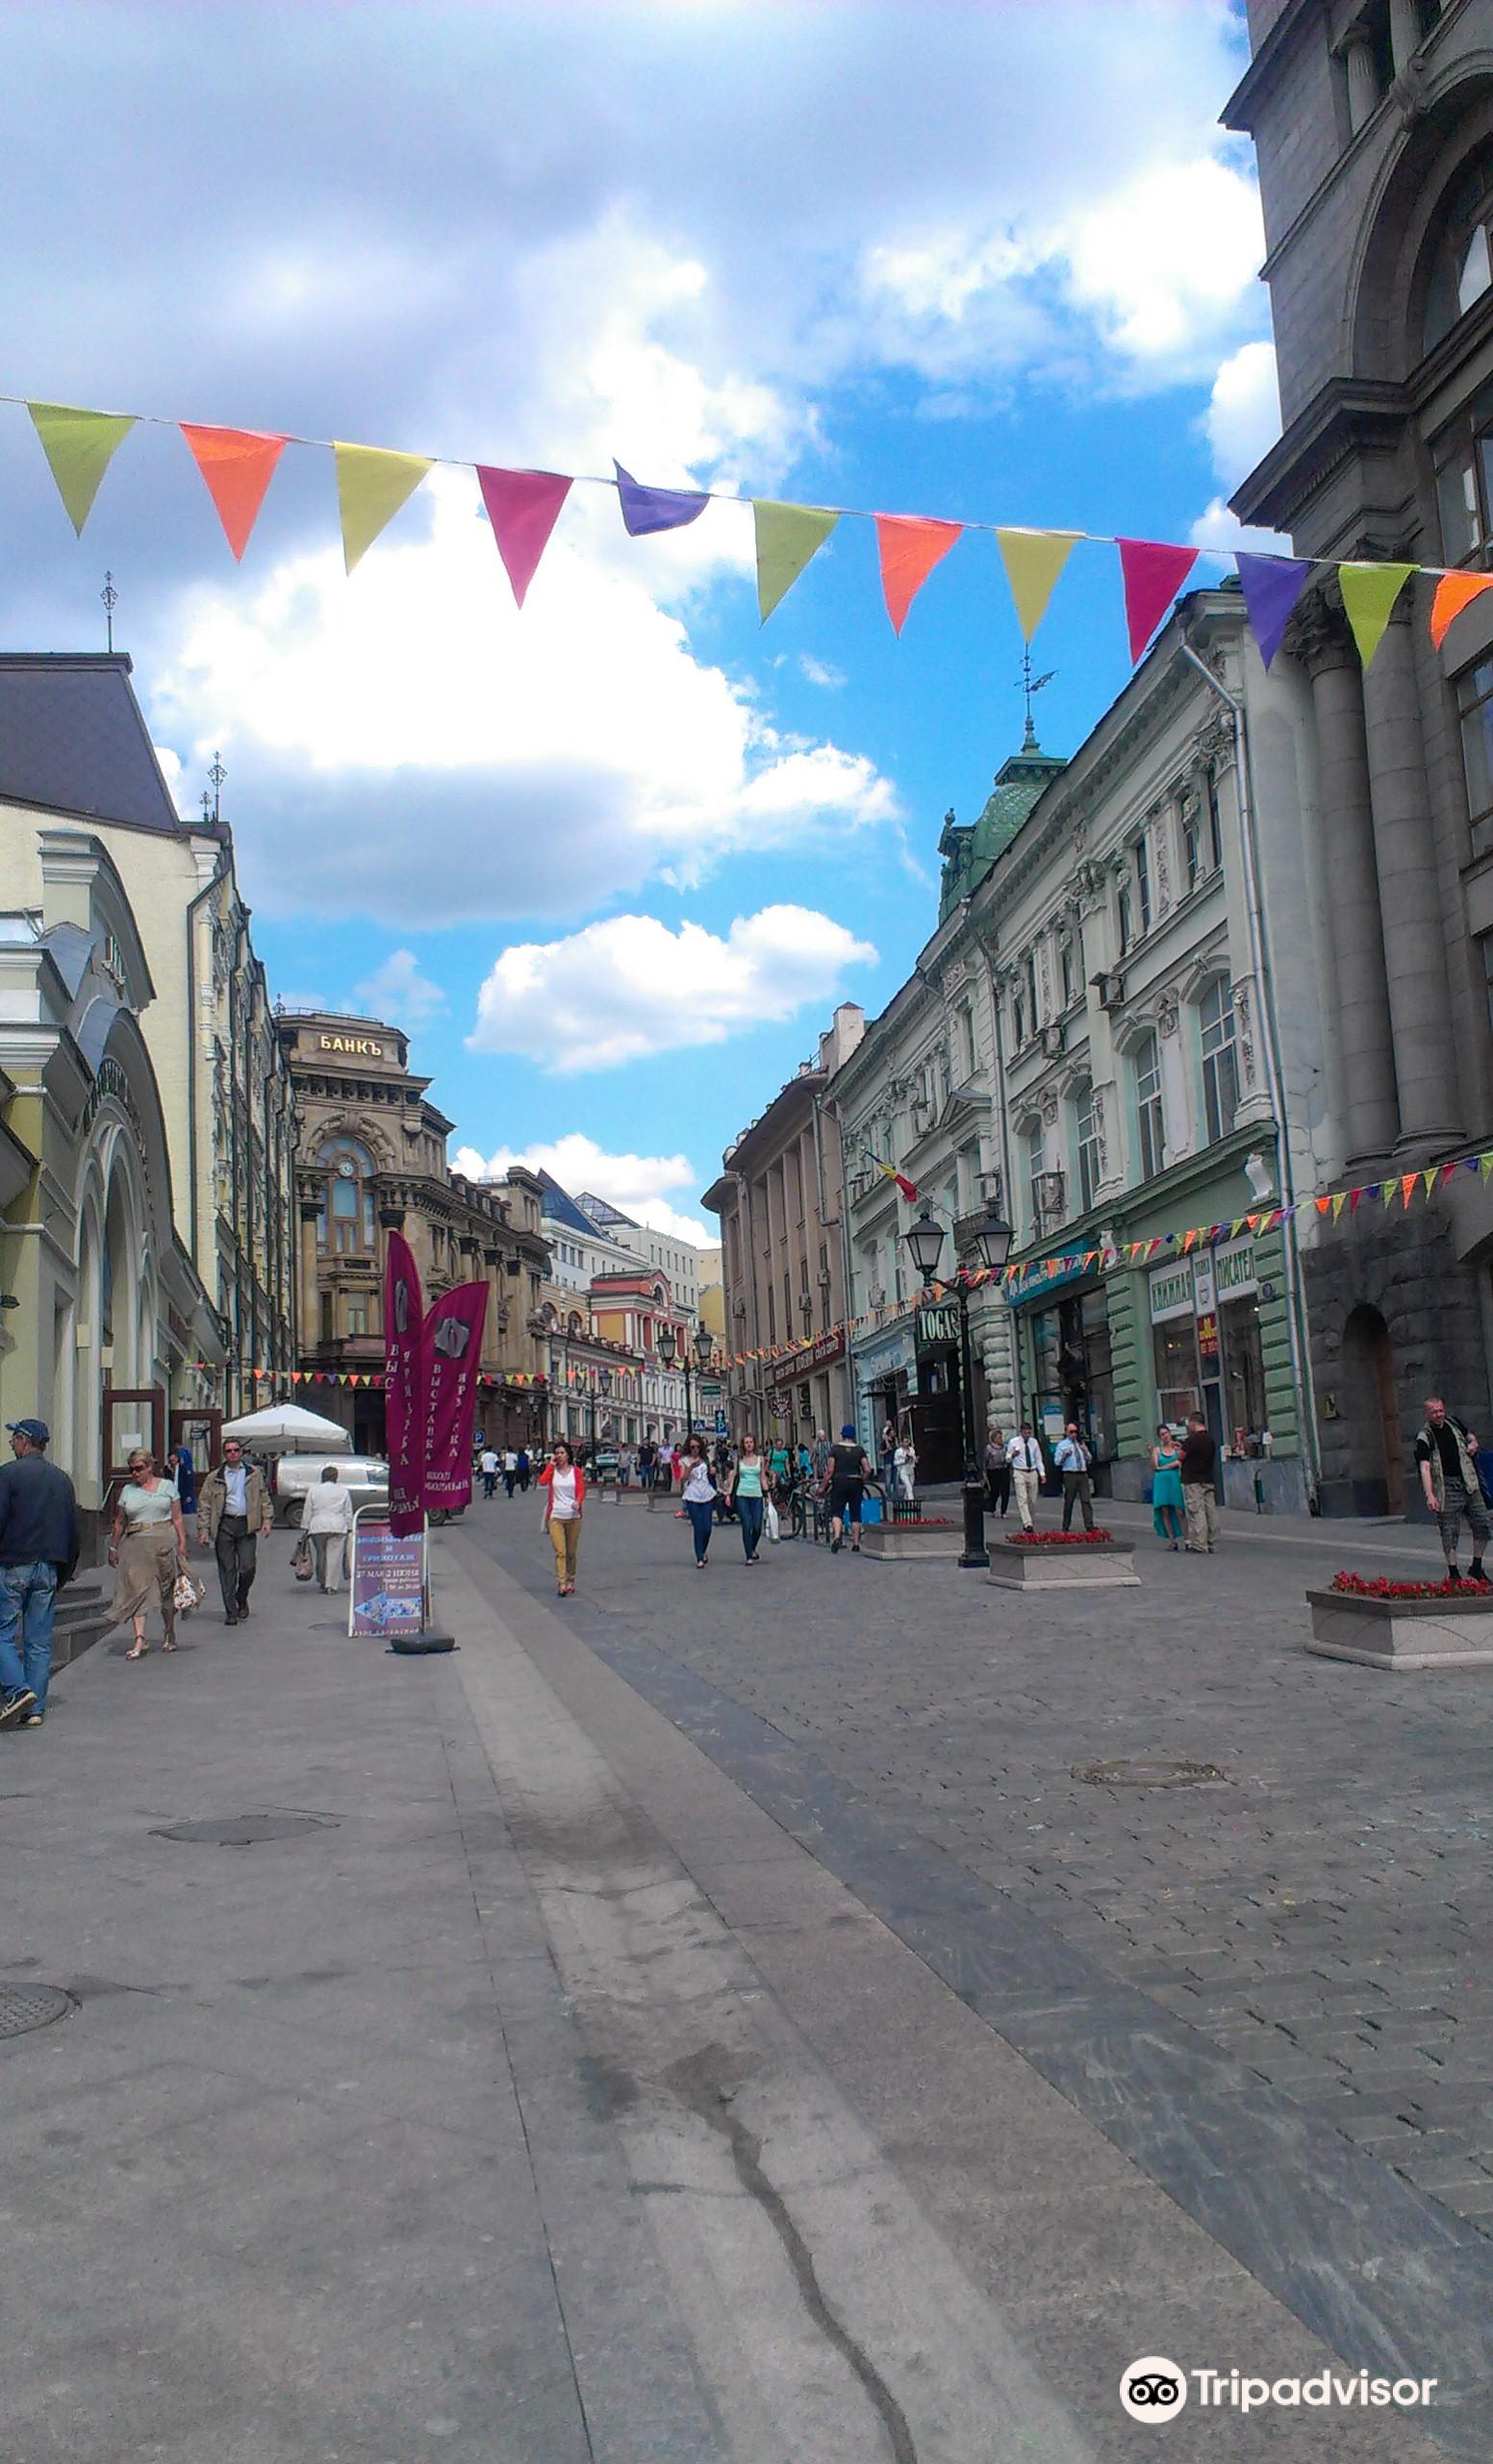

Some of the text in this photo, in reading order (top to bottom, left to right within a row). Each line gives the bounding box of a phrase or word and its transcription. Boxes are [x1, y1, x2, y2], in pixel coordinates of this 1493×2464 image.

[320, 1035, 382, 1057] БАНКЪ
[919, 1310, 958, 1340] TOGAS
[425, 1364, 442, 1461] ВЫСТАВКА
